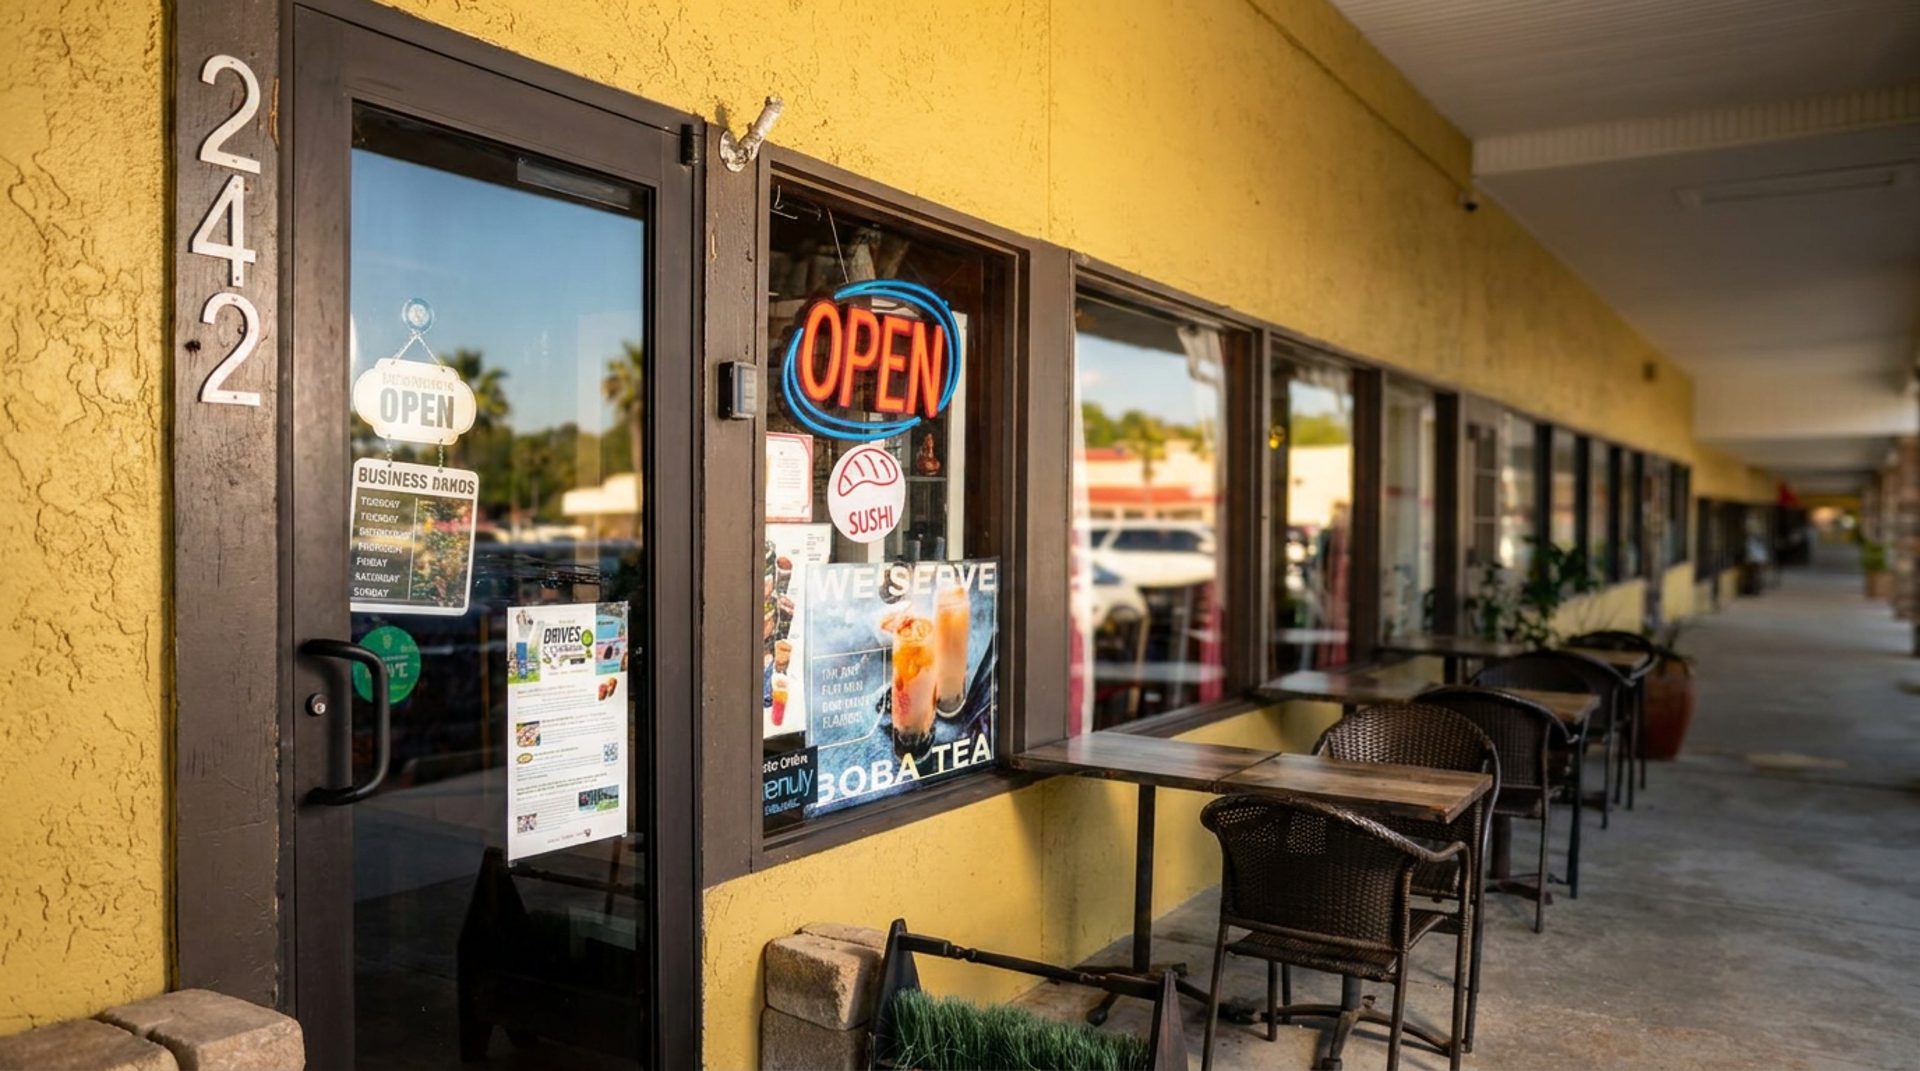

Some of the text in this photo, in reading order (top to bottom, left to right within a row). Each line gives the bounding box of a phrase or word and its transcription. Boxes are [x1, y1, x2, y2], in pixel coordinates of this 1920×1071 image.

[192, 54, 261, 406] 242
[800, 299, 945, 420] OPEN
[379, 387, 455, 430] OPEN
[358, 466, 428, 490] BUSINESS
[849, 504, 894, 536] SUSHI
[812, 567, 876, 600] WE
[817, 733, 993, 807] BOBA TEA
